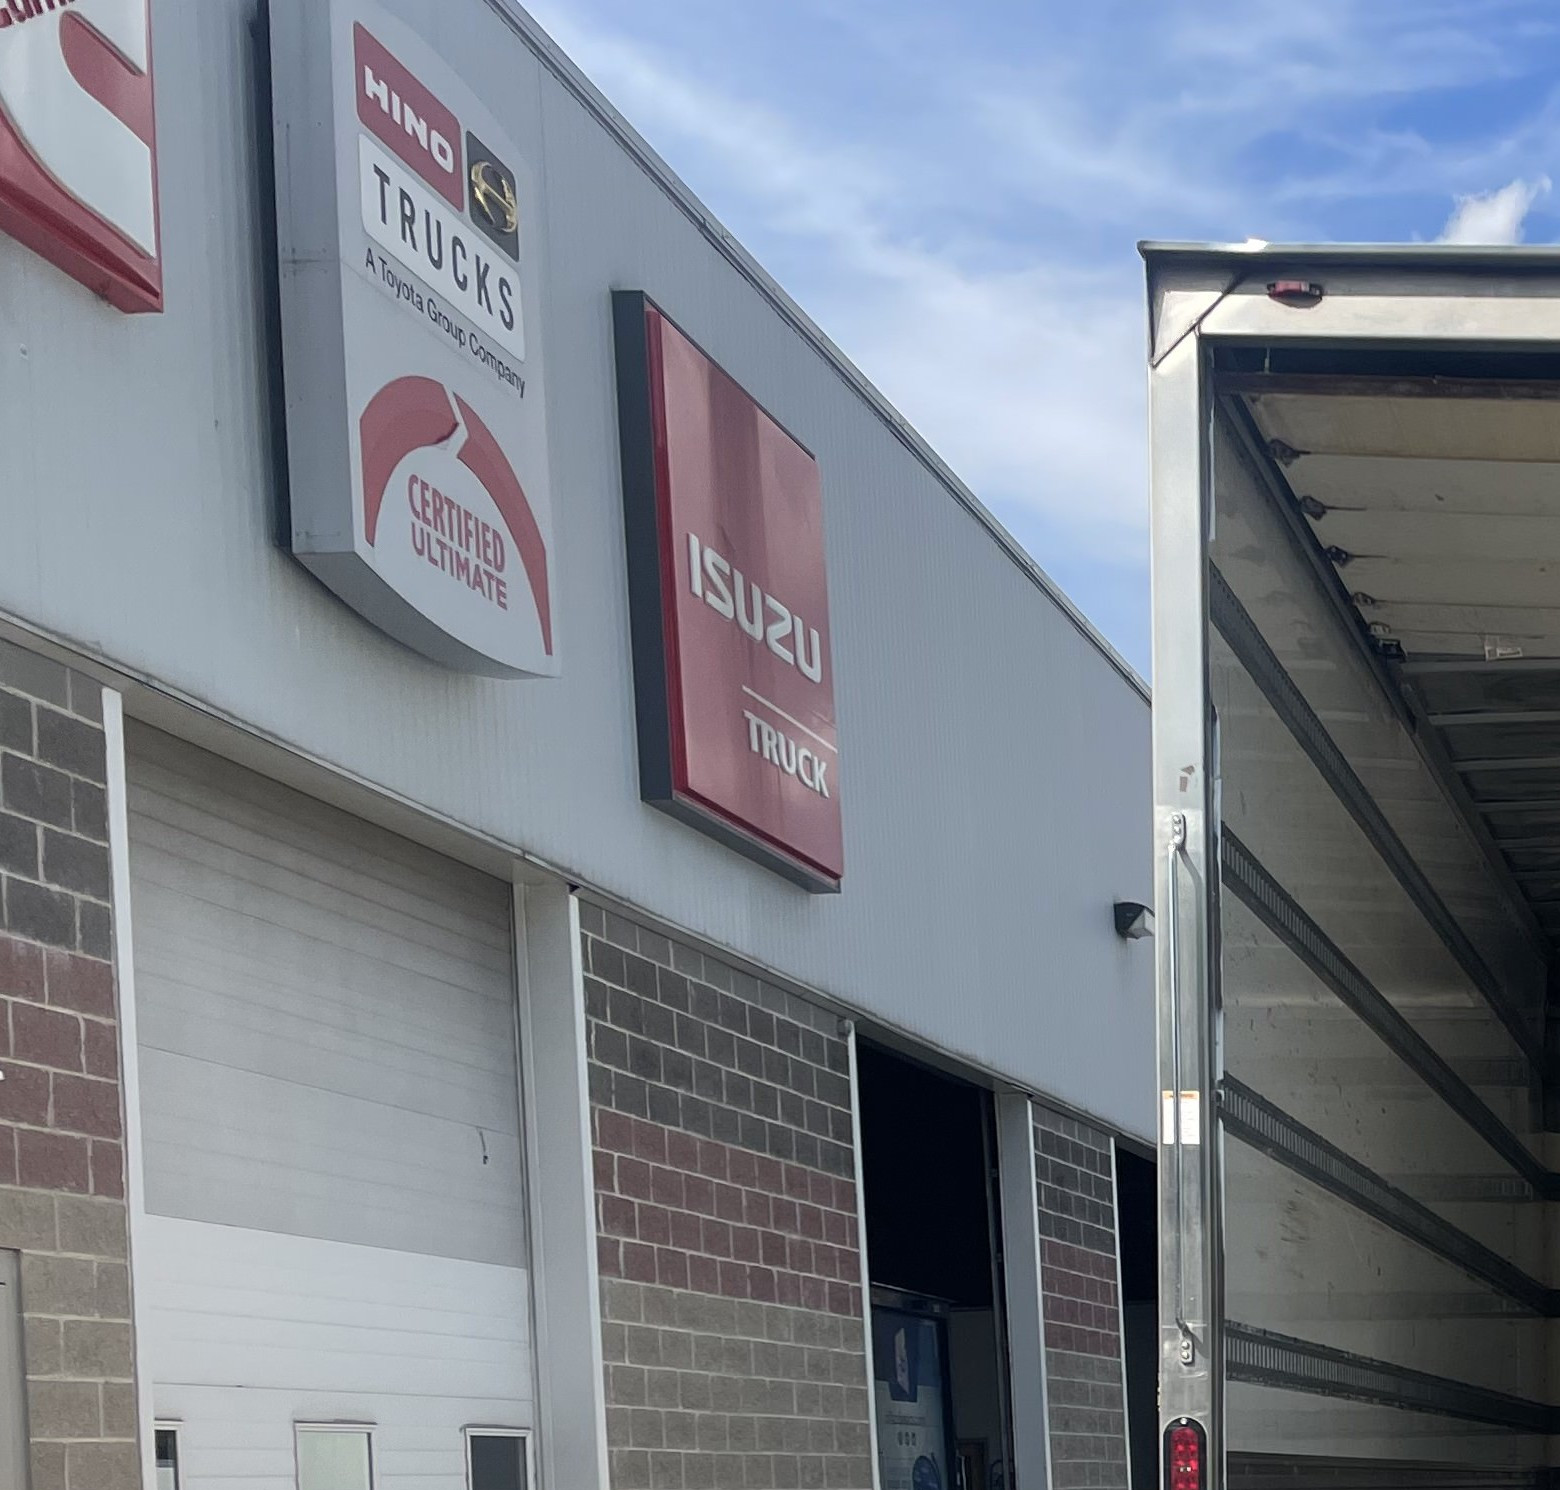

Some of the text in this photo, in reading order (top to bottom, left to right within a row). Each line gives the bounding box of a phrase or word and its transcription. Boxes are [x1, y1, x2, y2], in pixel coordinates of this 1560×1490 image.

[364, 65, 454, 173] HINO
[373, 163, 514, 332] TRUCKS
[365, 247, 526, 399] A Toyota Group Company
[408, 474, 506, 573] CERTIFIED
[411, 521, 508, 611] ULTIMATE
[687, 531, 822, 684] ISUZU
[743, 709, 830, 798] TRUCK
